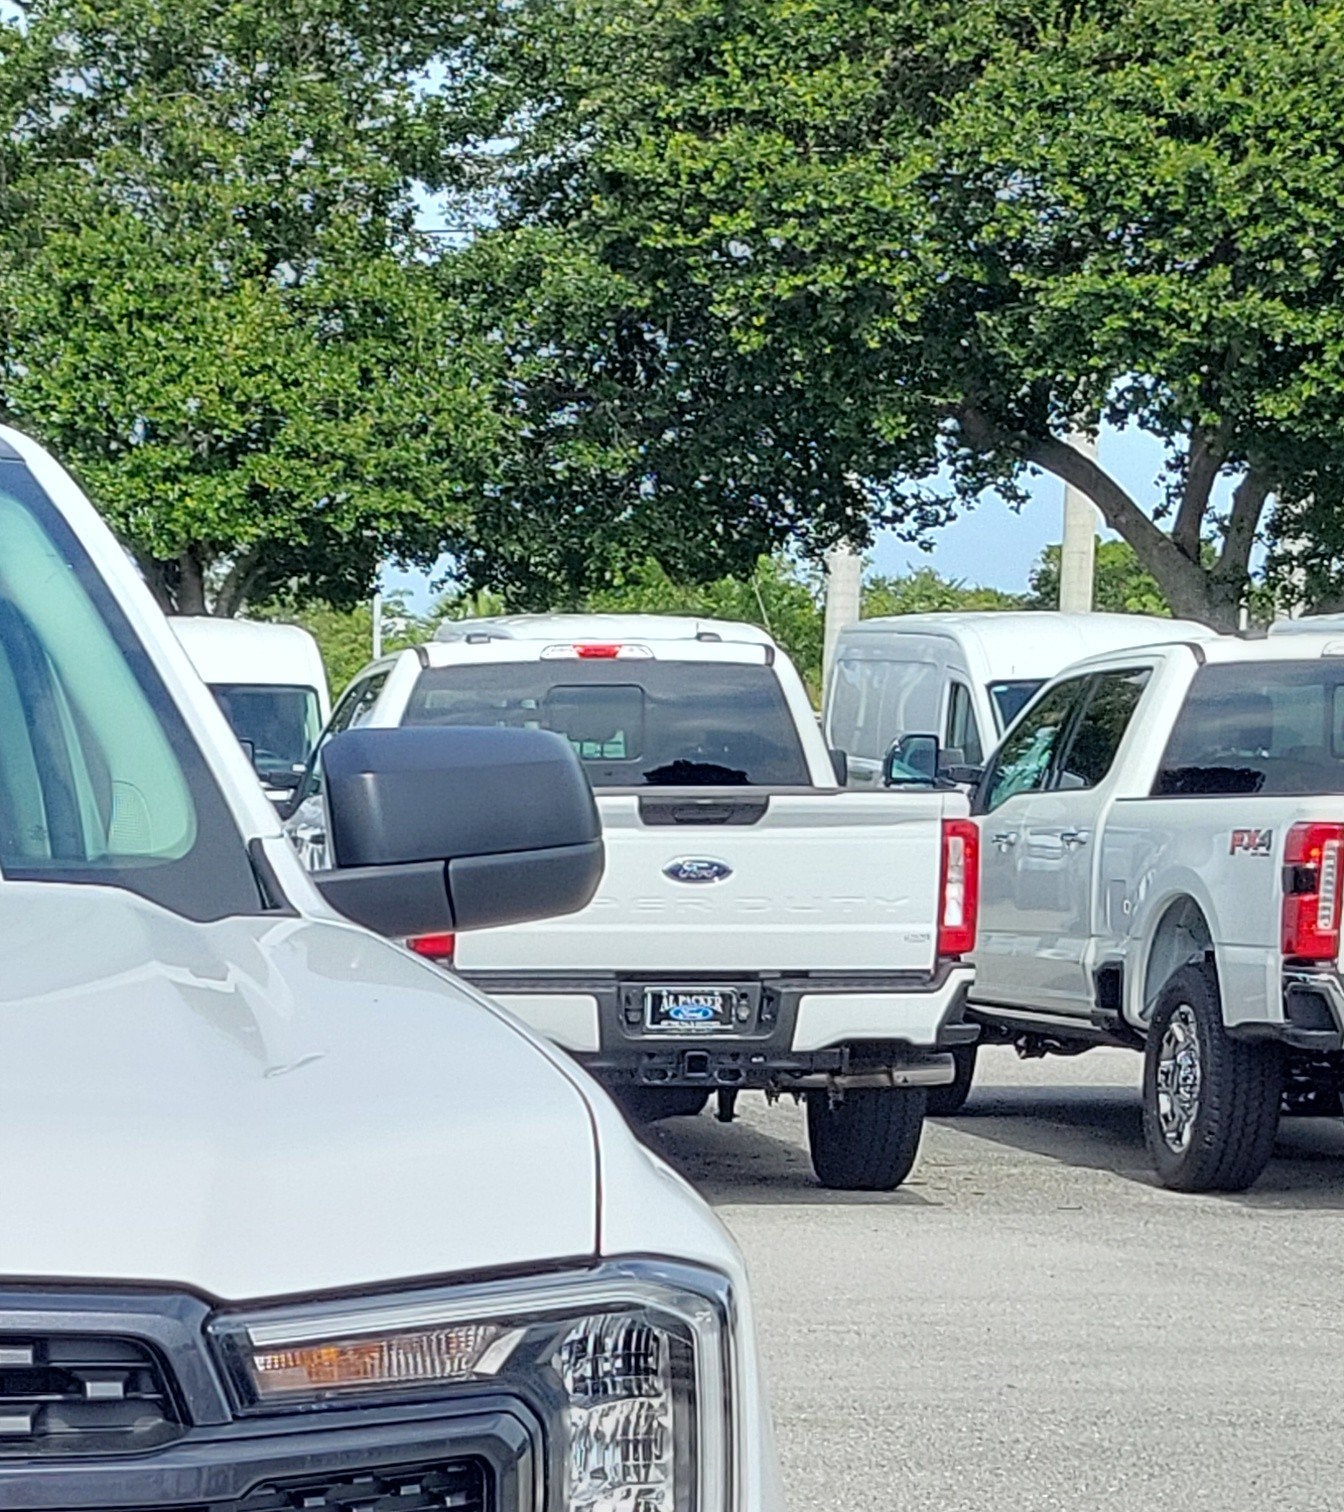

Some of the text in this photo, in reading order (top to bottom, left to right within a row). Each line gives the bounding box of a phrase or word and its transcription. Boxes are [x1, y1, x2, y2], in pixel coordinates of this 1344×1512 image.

[1229, 829, 1273, 855] FX4
[679, 861, 718, 878] Ford
[678, 994, 723, 1013] PACKER
